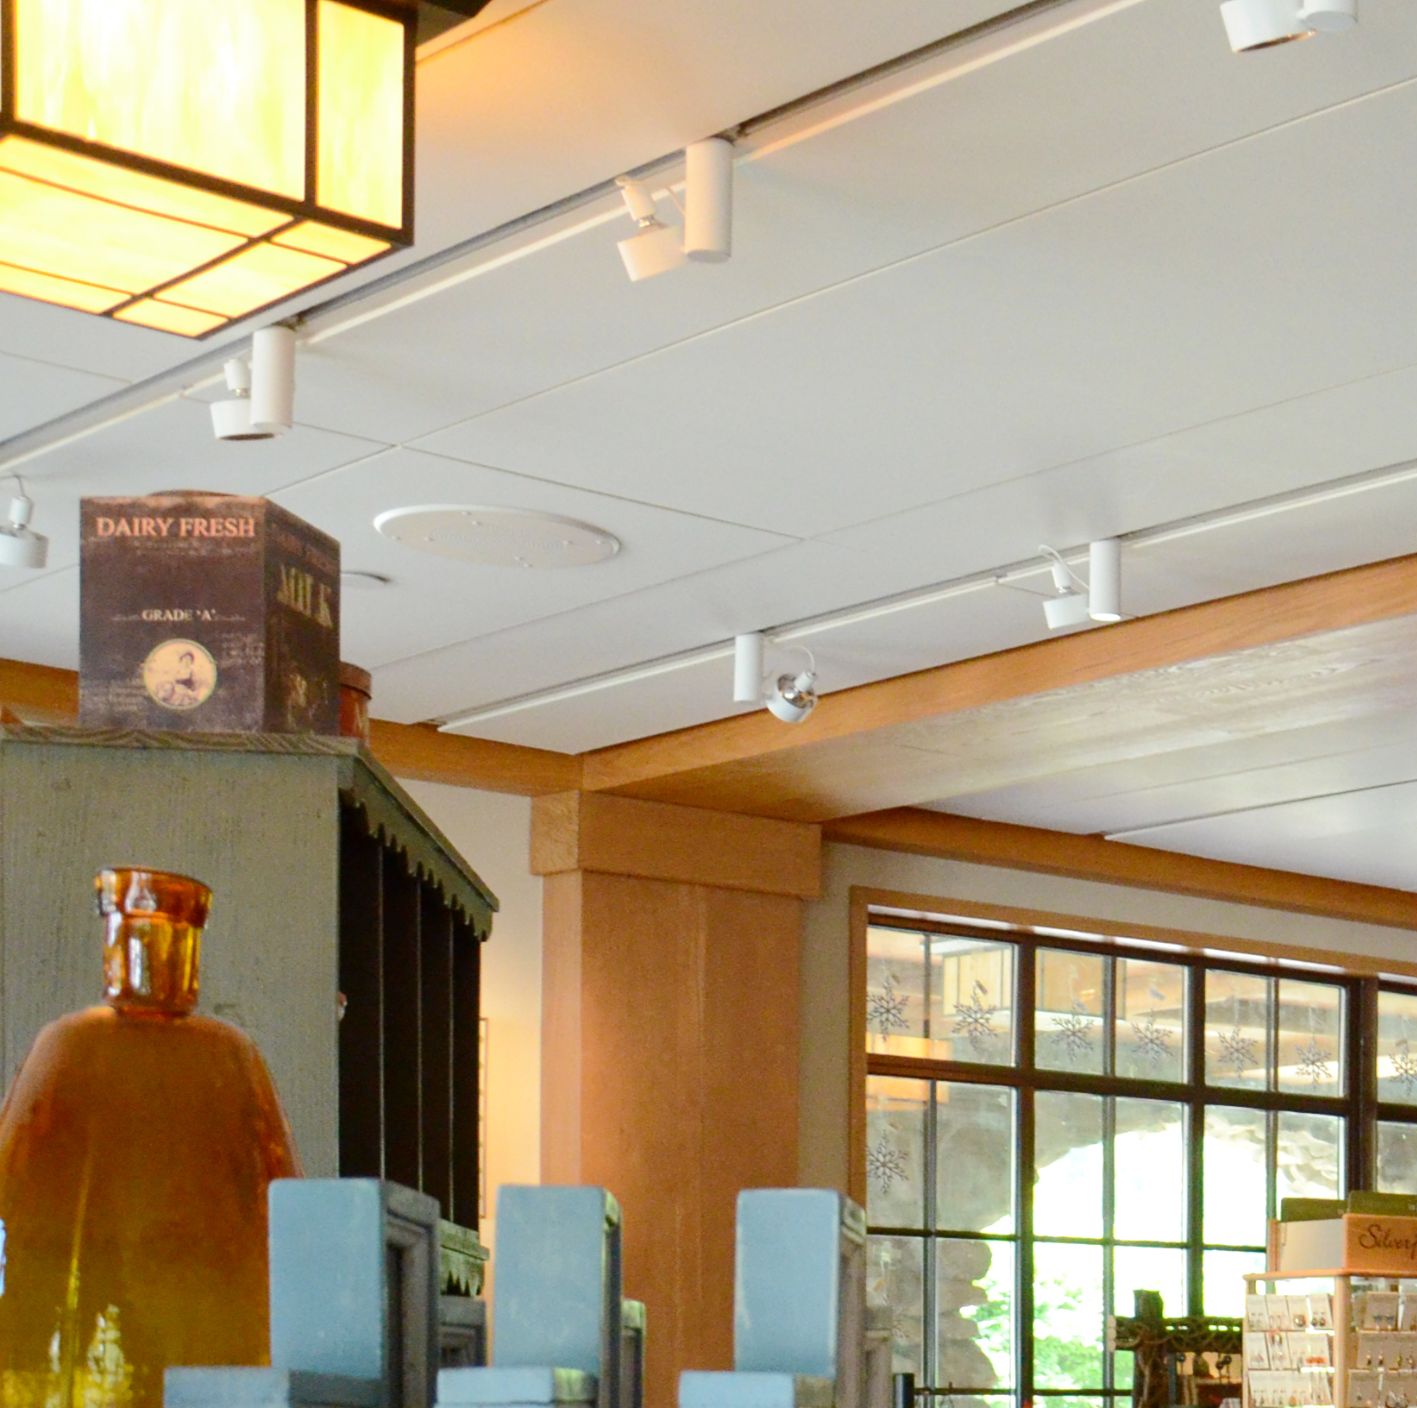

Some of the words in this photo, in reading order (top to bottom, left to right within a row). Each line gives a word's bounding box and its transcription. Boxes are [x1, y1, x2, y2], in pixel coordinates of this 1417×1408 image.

[96, 517, 175, 537] DAIRY
[179, 518, 256, 537] FRESH
[142, 609, 192, 621] GRADE
